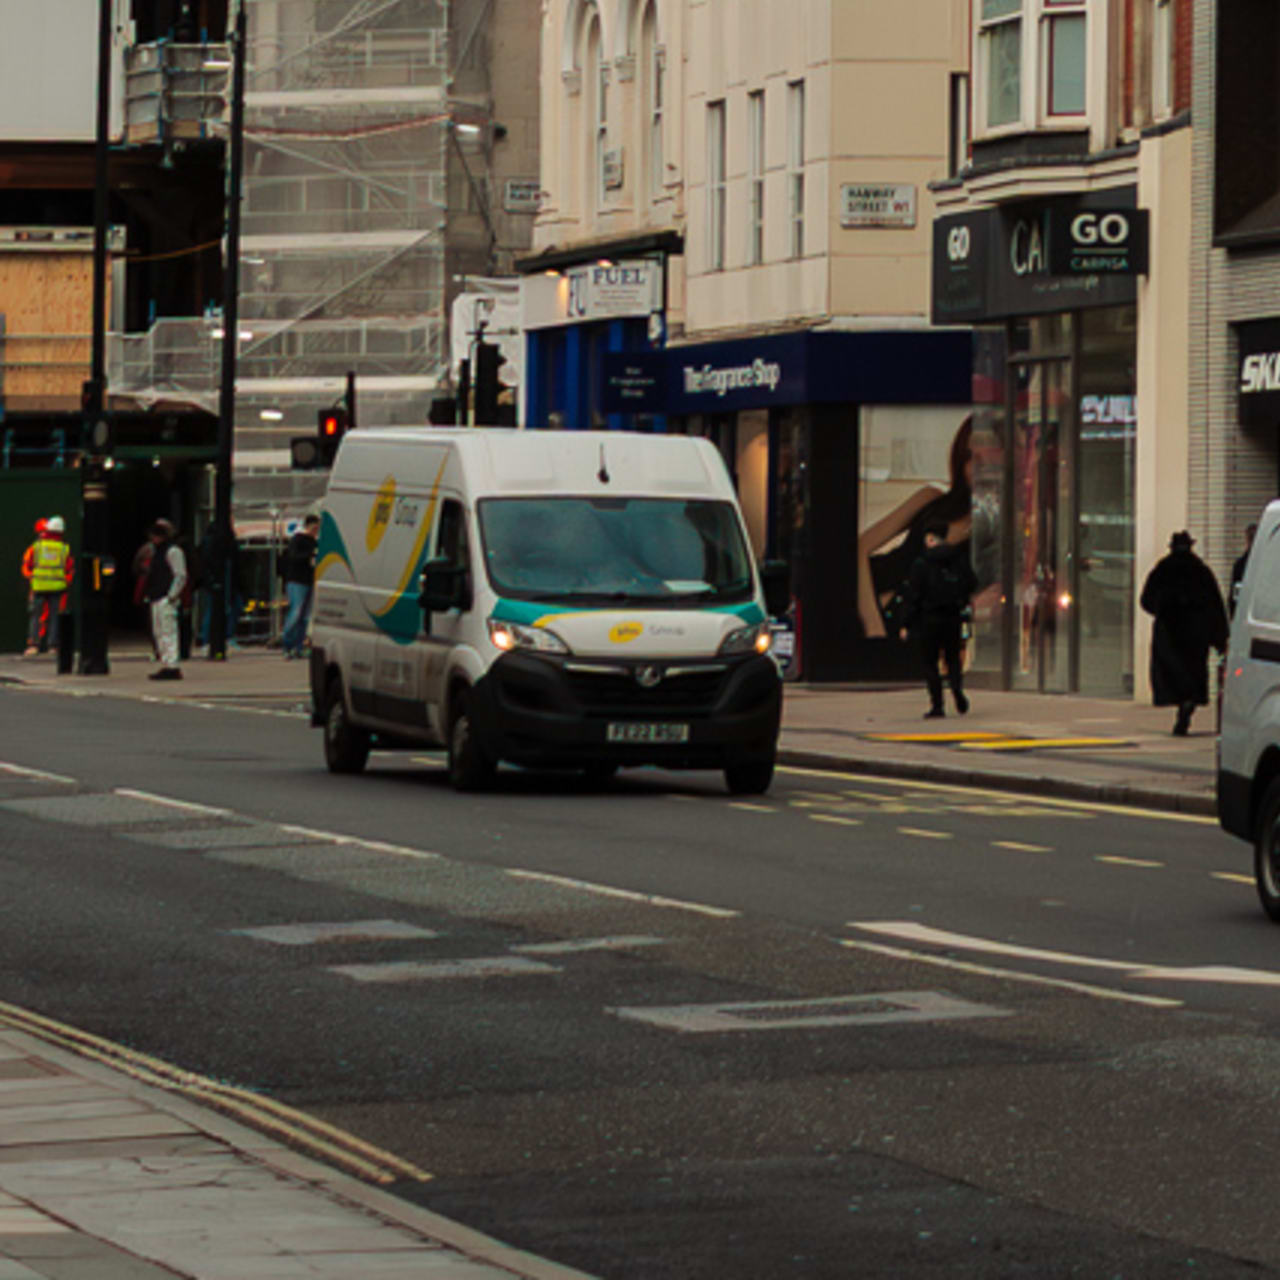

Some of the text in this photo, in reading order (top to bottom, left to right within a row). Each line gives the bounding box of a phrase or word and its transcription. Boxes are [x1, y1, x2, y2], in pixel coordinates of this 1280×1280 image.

[848, 201, 889, 213] STREET
[1071, 213, 1130, 245] GO
[948, 226, 970, 261] GO
[1071, 256, 1129, 271] CARPISA
[594, 268, 646, 285] FUEL
